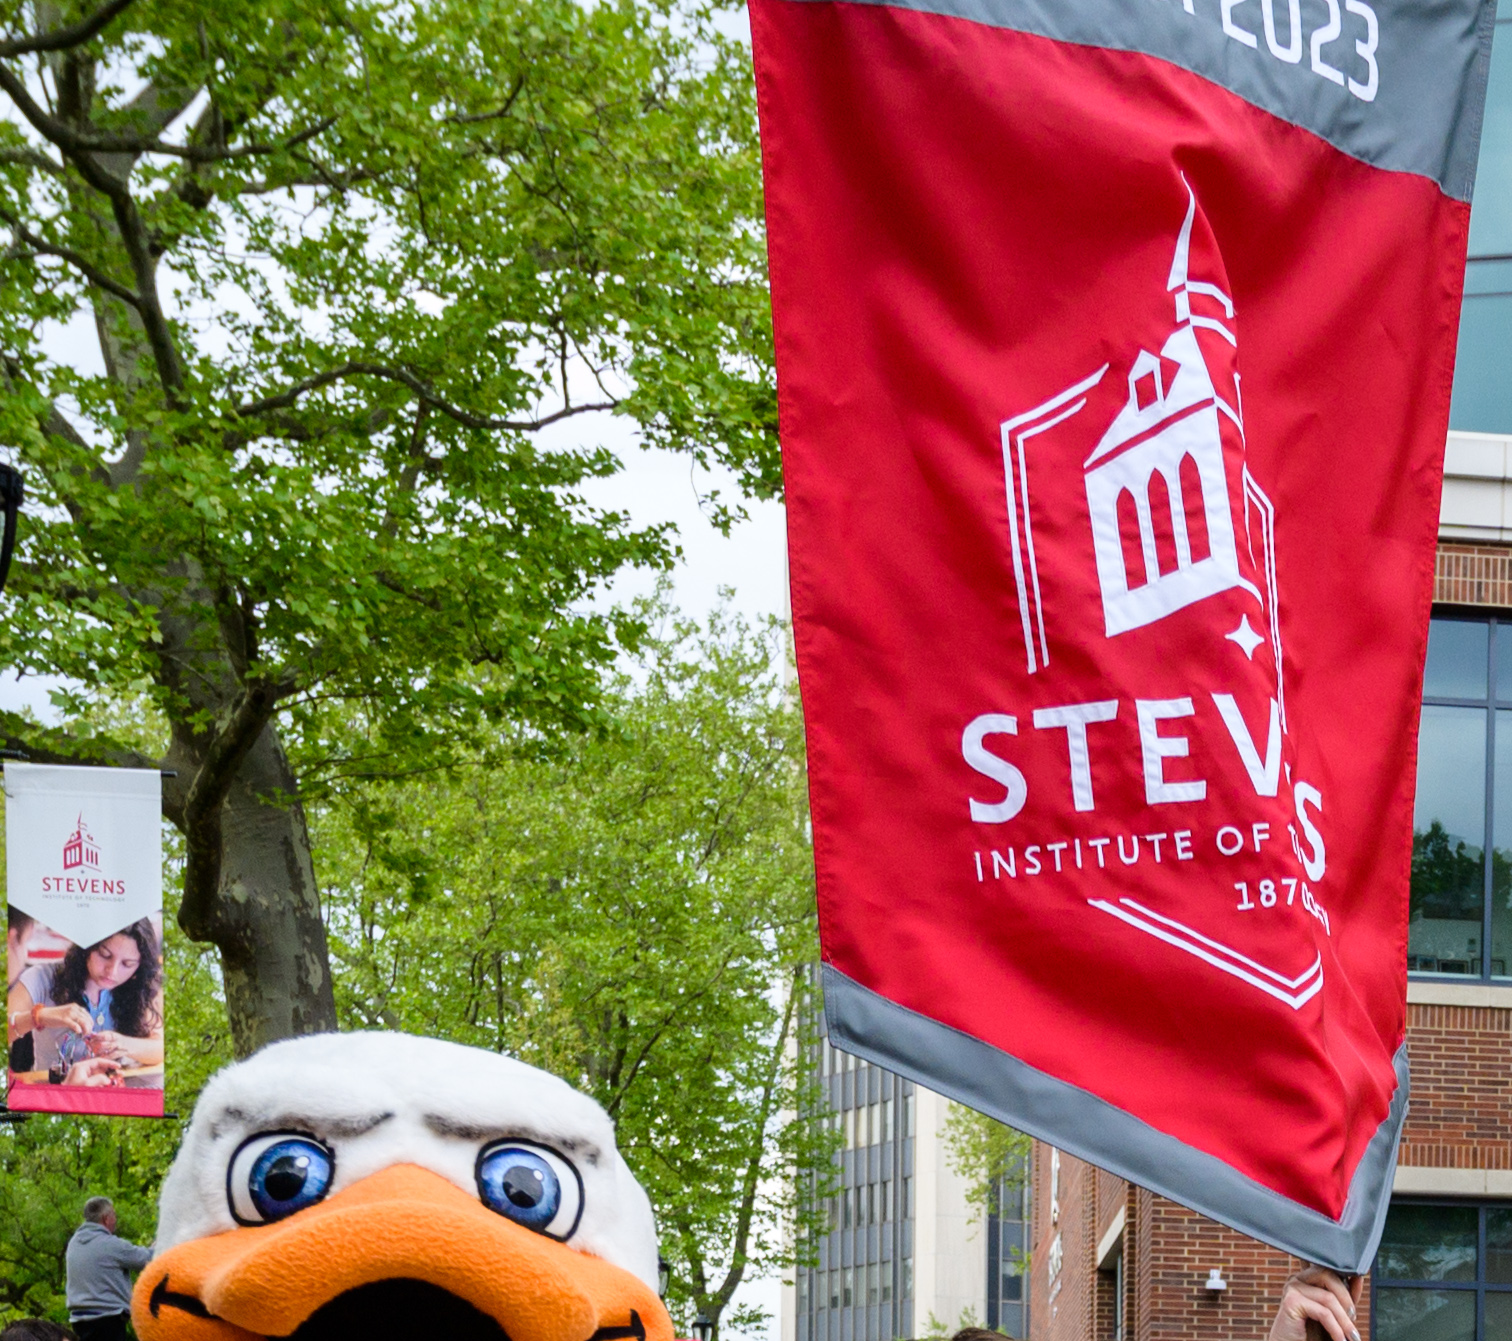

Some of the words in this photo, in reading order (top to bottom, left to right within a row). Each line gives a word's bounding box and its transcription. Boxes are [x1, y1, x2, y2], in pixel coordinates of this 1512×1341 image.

[961, 692, 1326, 882] STEVS
[974, 831, 1193, 882] INSTITUTE
[1216, 823, 1270, 856] OF
[41, 876, 126, 895] STEVENS
